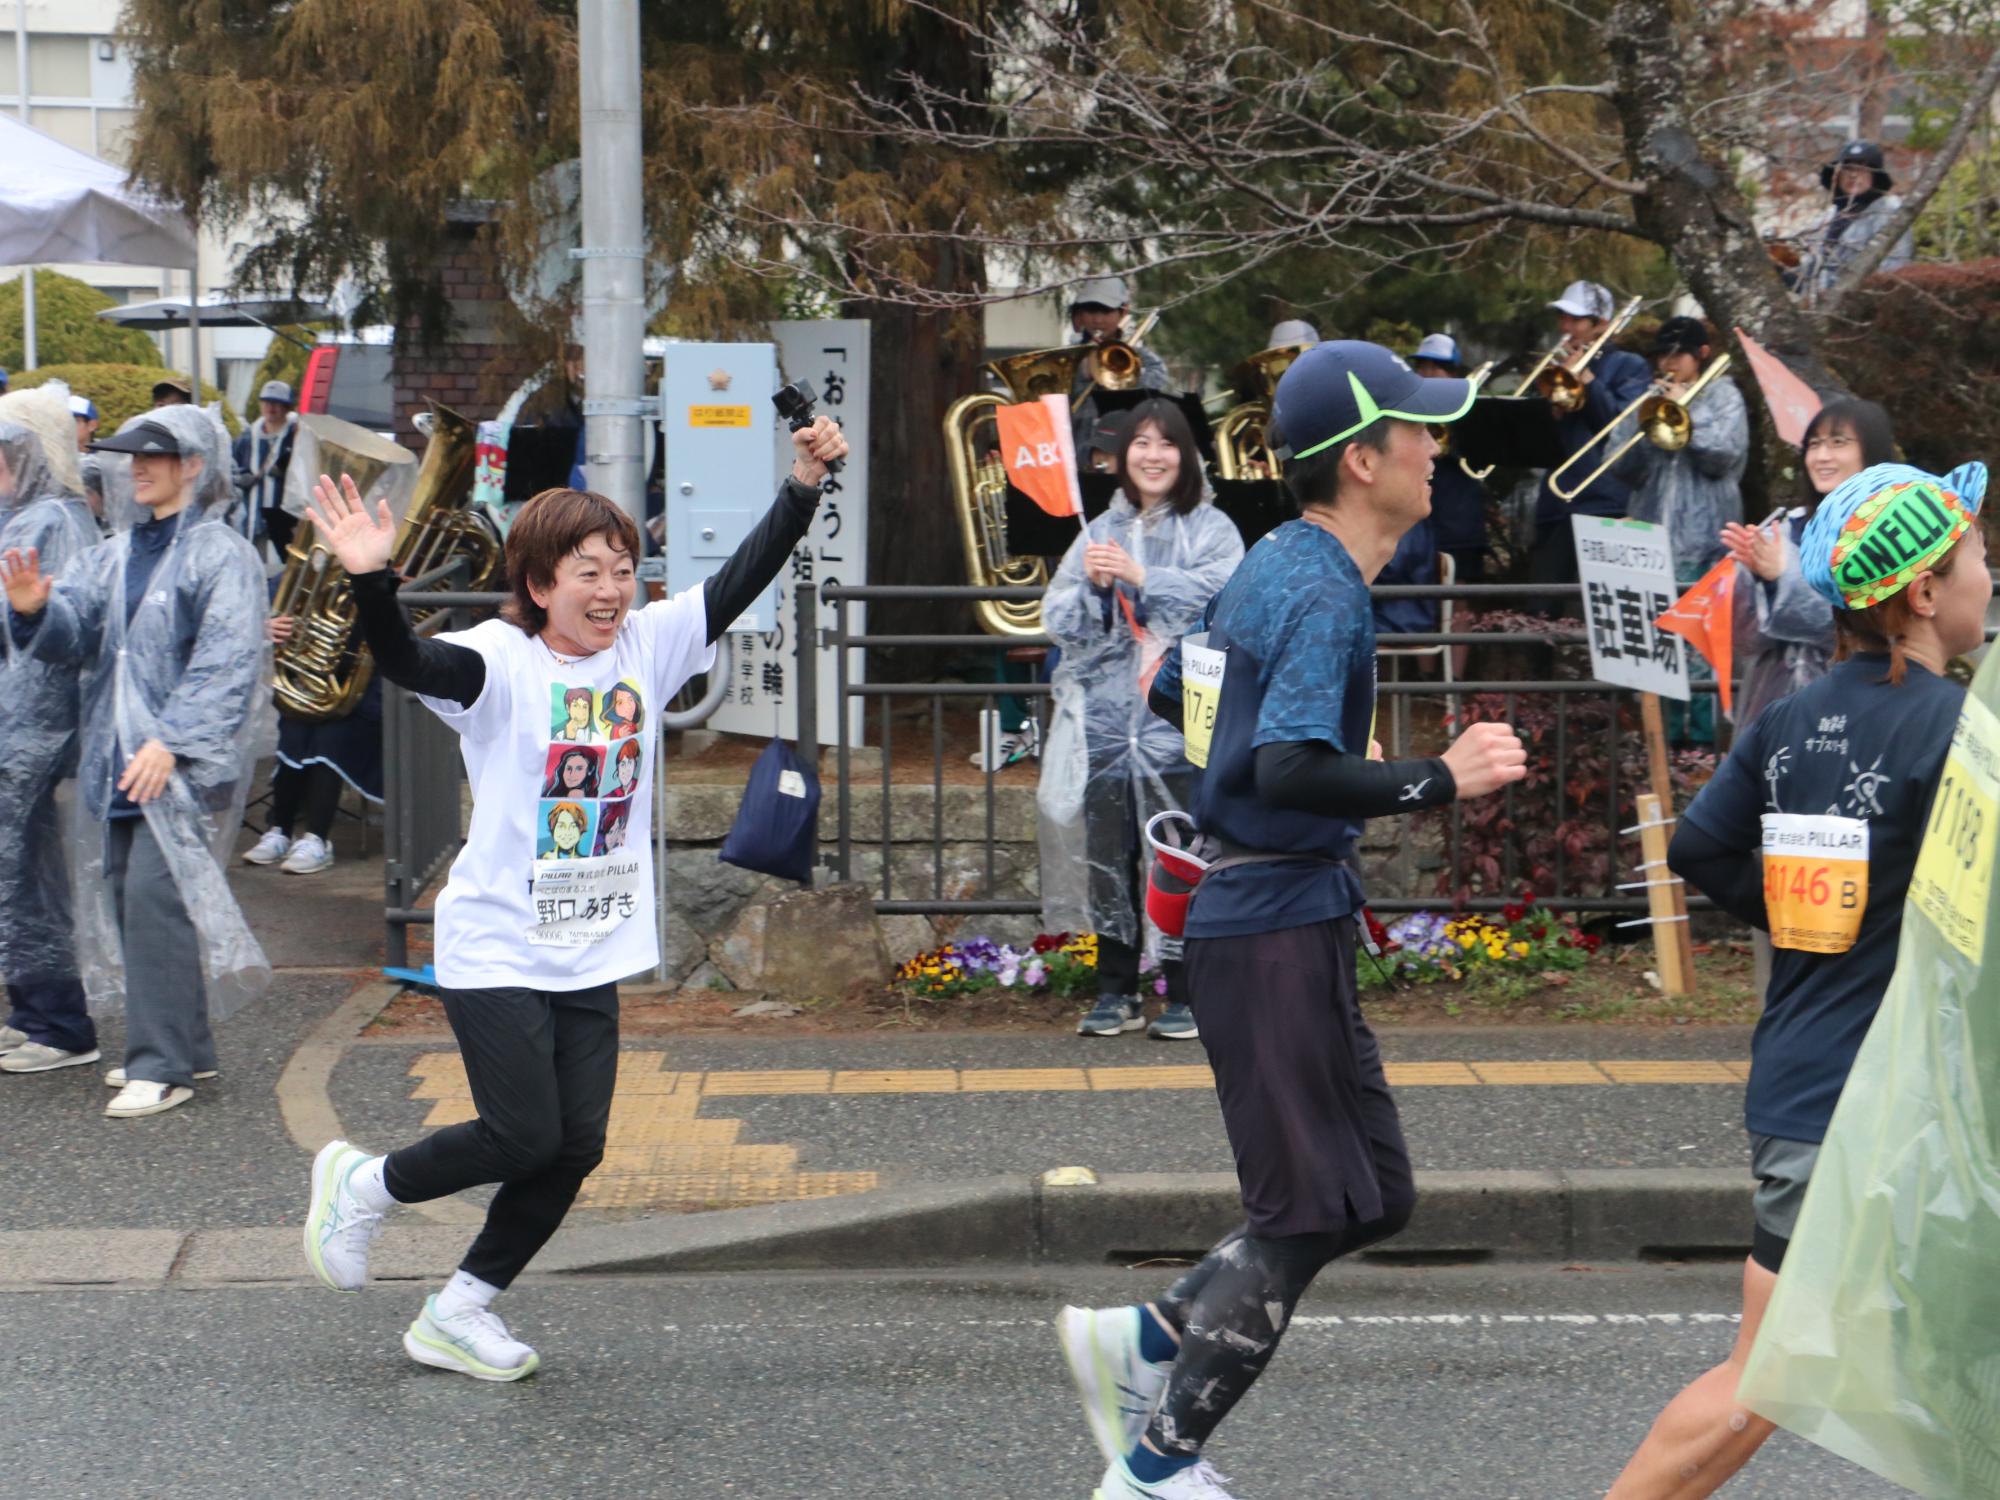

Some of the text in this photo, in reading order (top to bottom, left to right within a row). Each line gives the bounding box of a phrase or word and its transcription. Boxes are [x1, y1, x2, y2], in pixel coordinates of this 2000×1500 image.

[1842, 488, 1951, 586] CINELLI
[1587, 581, 1679, 674] 駐車場
[1840, 880, 1857, 909] B
